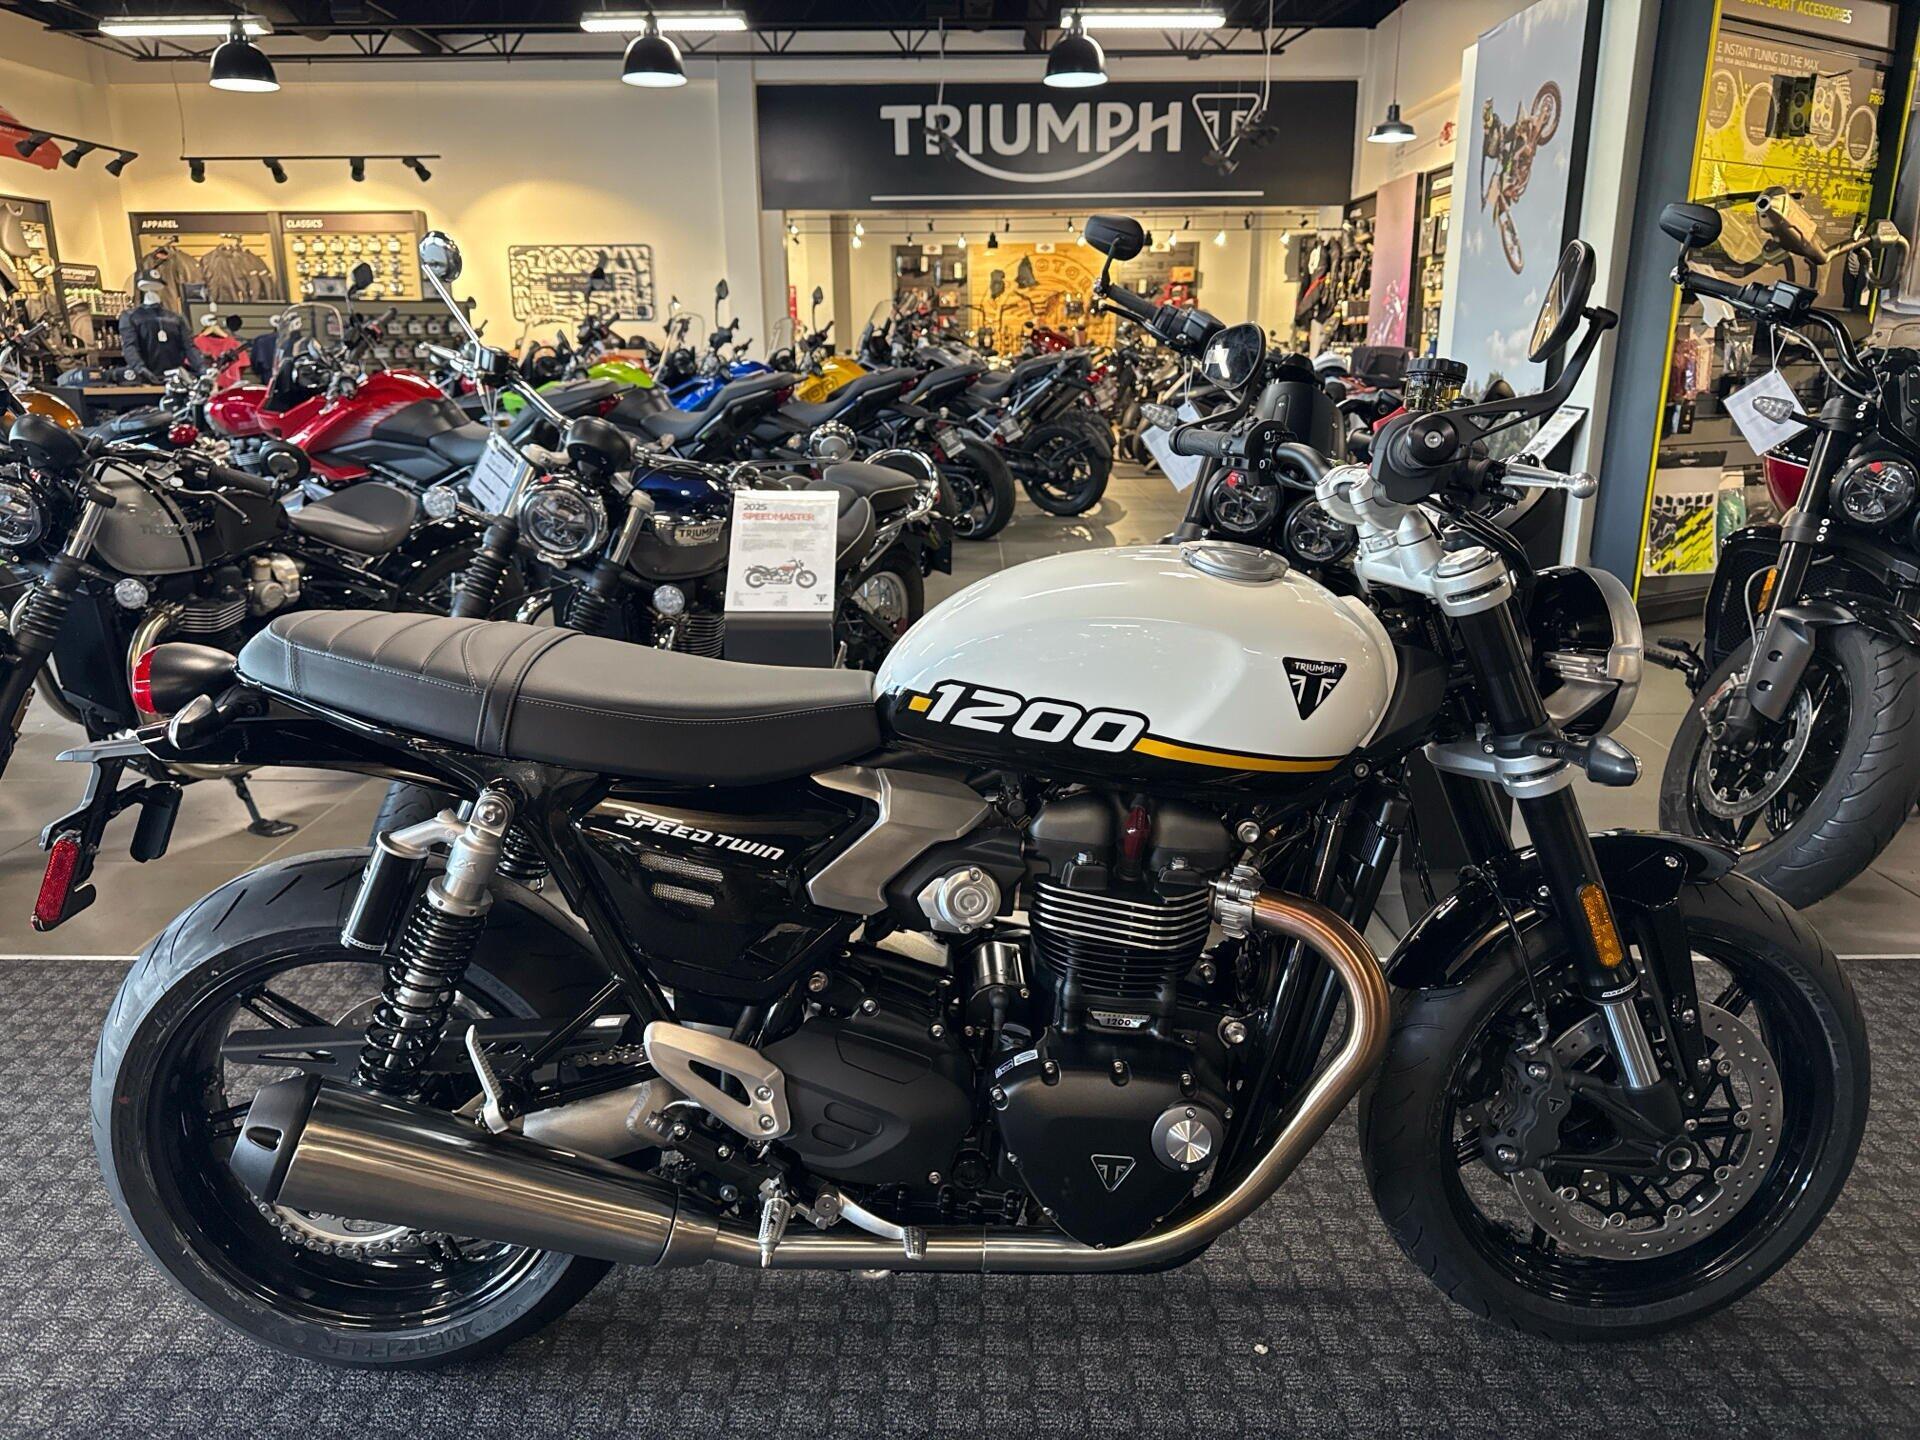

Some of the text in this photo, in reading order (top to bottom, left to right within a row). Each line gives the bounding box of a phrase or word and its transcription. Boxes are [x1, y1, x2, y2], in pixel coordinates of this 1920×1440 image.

[1766, 0, 1794, 12] SPORT
[1796, 0, 1852, 24] ACCESSORIES
[1724, 43, 1752, 58] INSTANT
[1754, 47, 1778, 64] TUNING
[1780, 53, 1789, 66] TO
[1790, 54, 1803, 68] THE
[1803, 58, 1820, 71] MAX
[880, 101, 1183, 183] TRIUMPH
[142, 220, 178, 229] APPAREL
[286, 219, 323, 229] CLASSICS
[1034, 257, 1093, 294] OTOR
[743, 503, 768, 511] 2025
[742, 512, 815, 521] SPEEDMASTER
[679, 527, 719, 541] TRIUMPH
[1294, 661, 1335, 676] TRIUMPH
[926, 684, 1146, 753] 1200
[616, 812, 785, 861] SPEED TWIN
[1106, 1018, 1132, 1026] 1200
